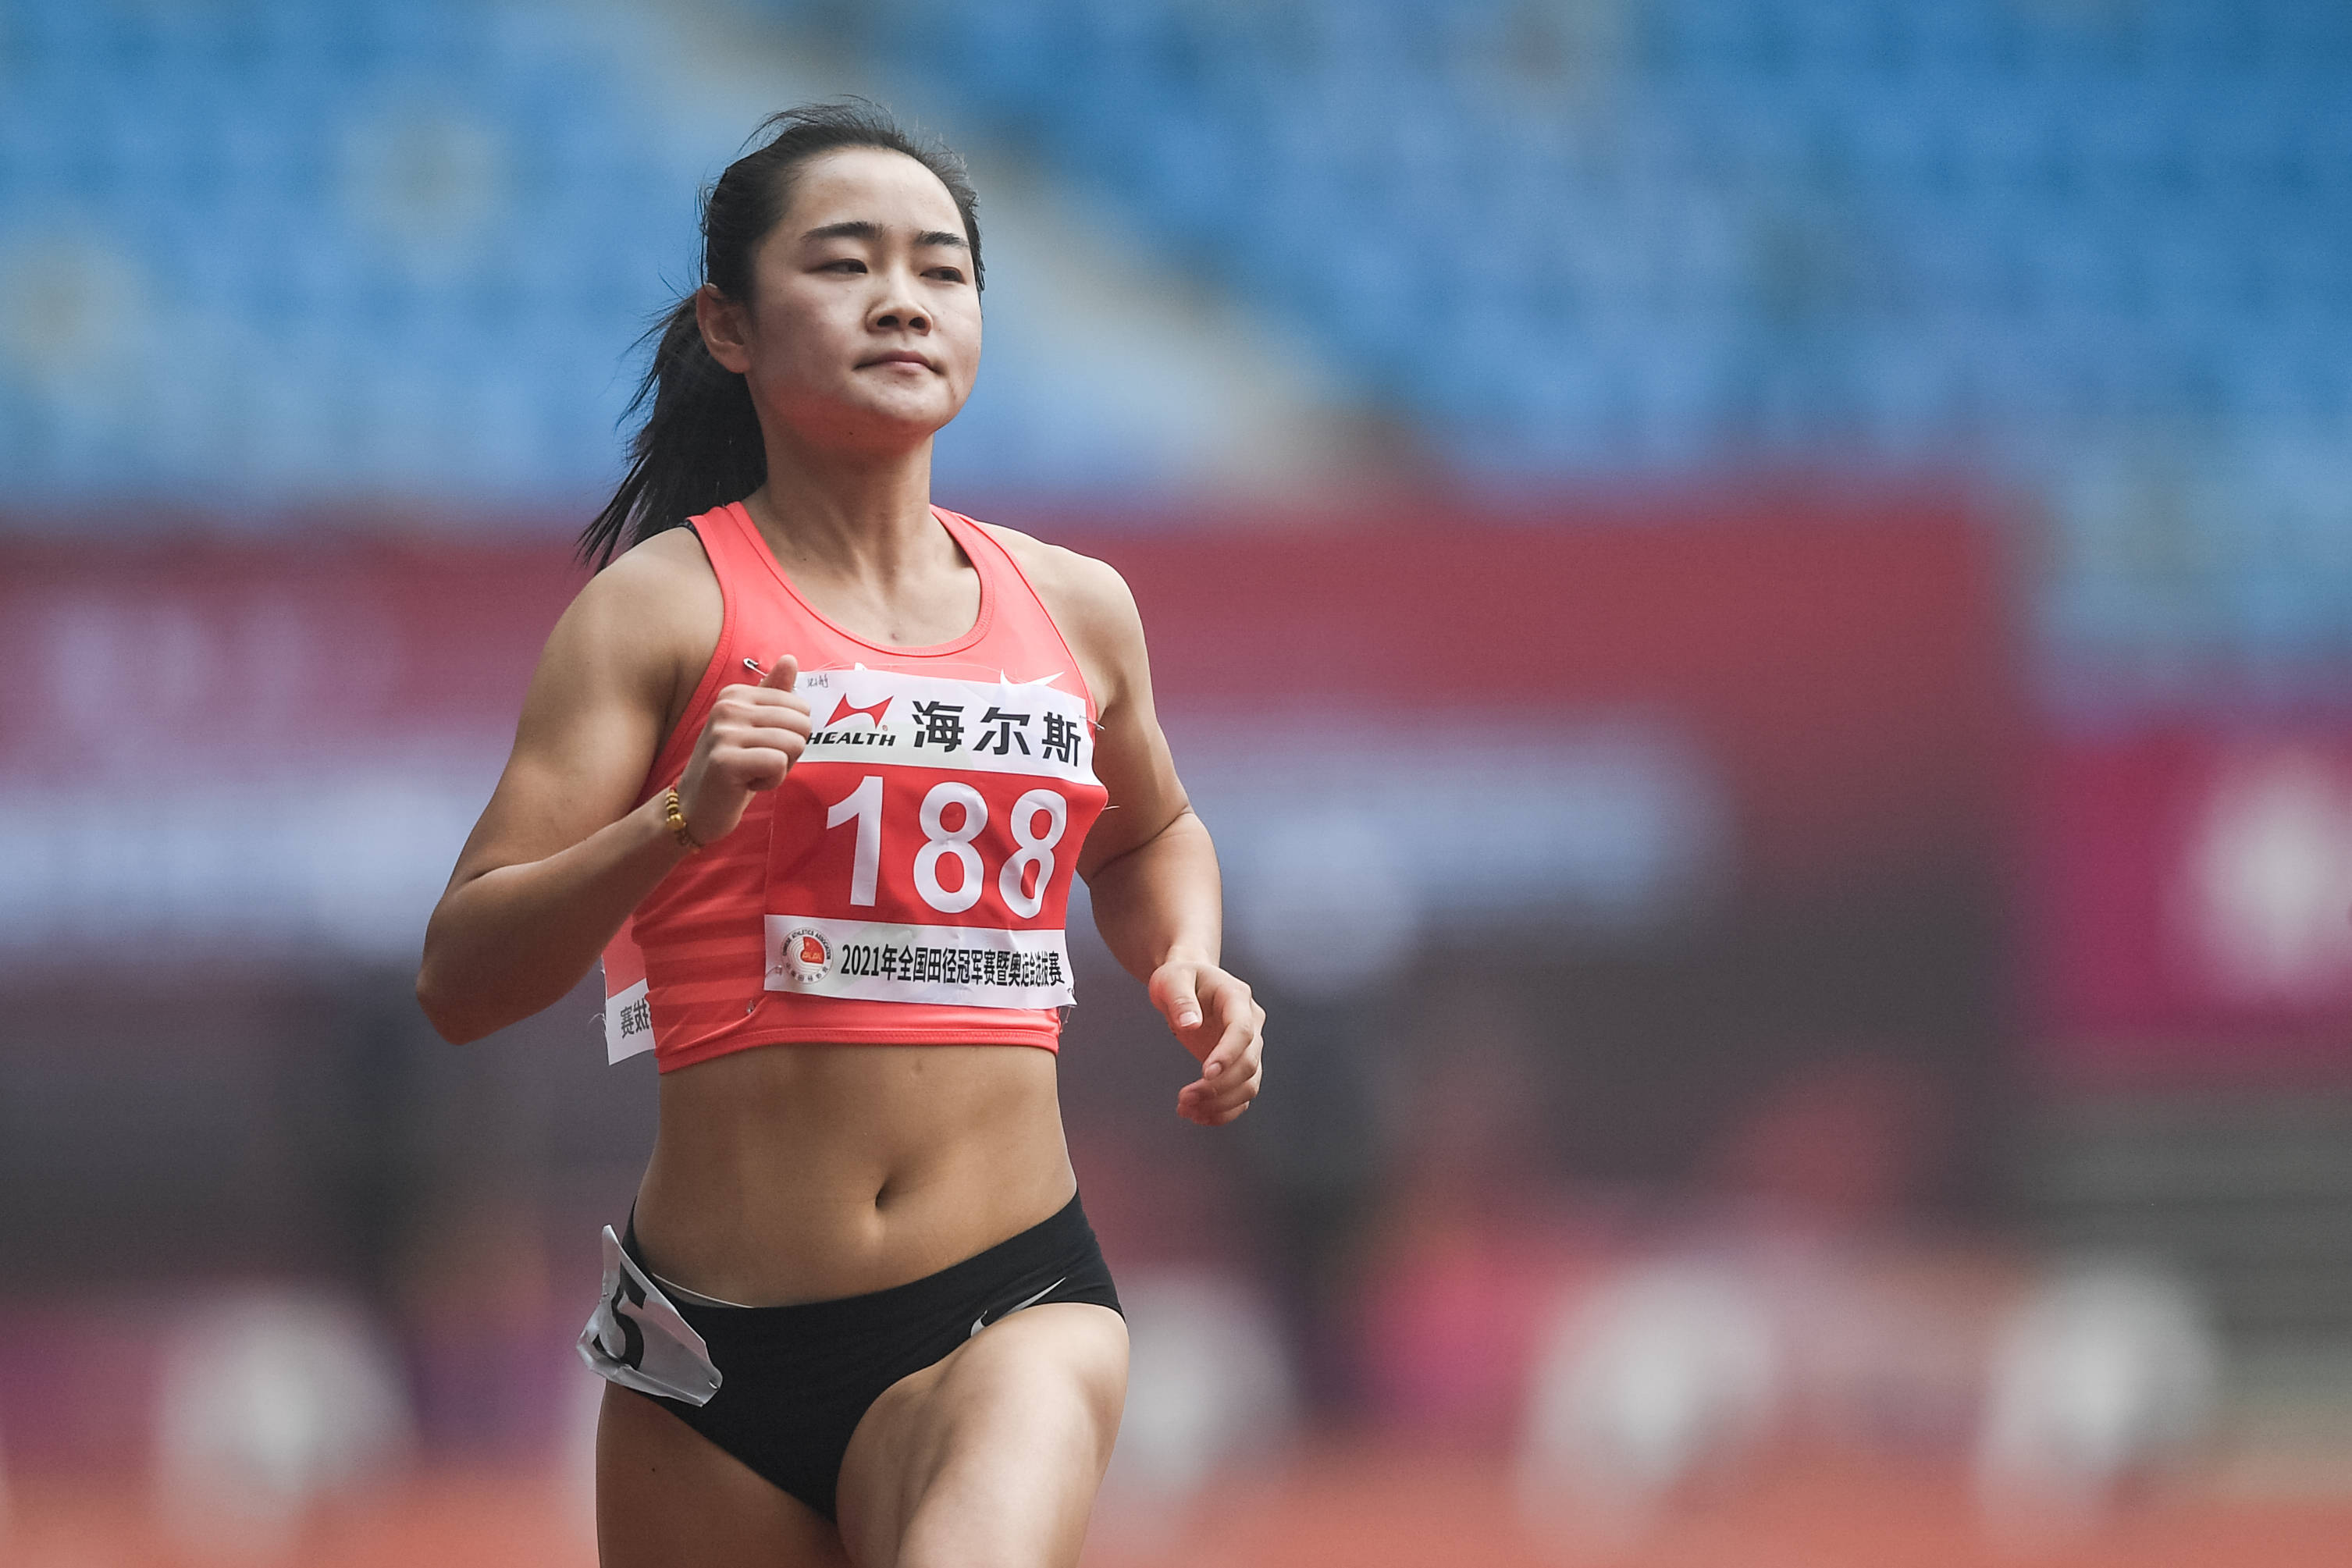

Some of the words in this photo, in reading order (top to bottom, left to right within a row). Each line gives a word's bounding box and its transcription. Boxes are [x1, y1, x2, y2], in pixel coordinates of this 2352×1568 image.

[806, 731, 896, 747] HEALTH
[912, 700, 1081, 767] 海尔斯
[827, 775, 1067, 919] 188
